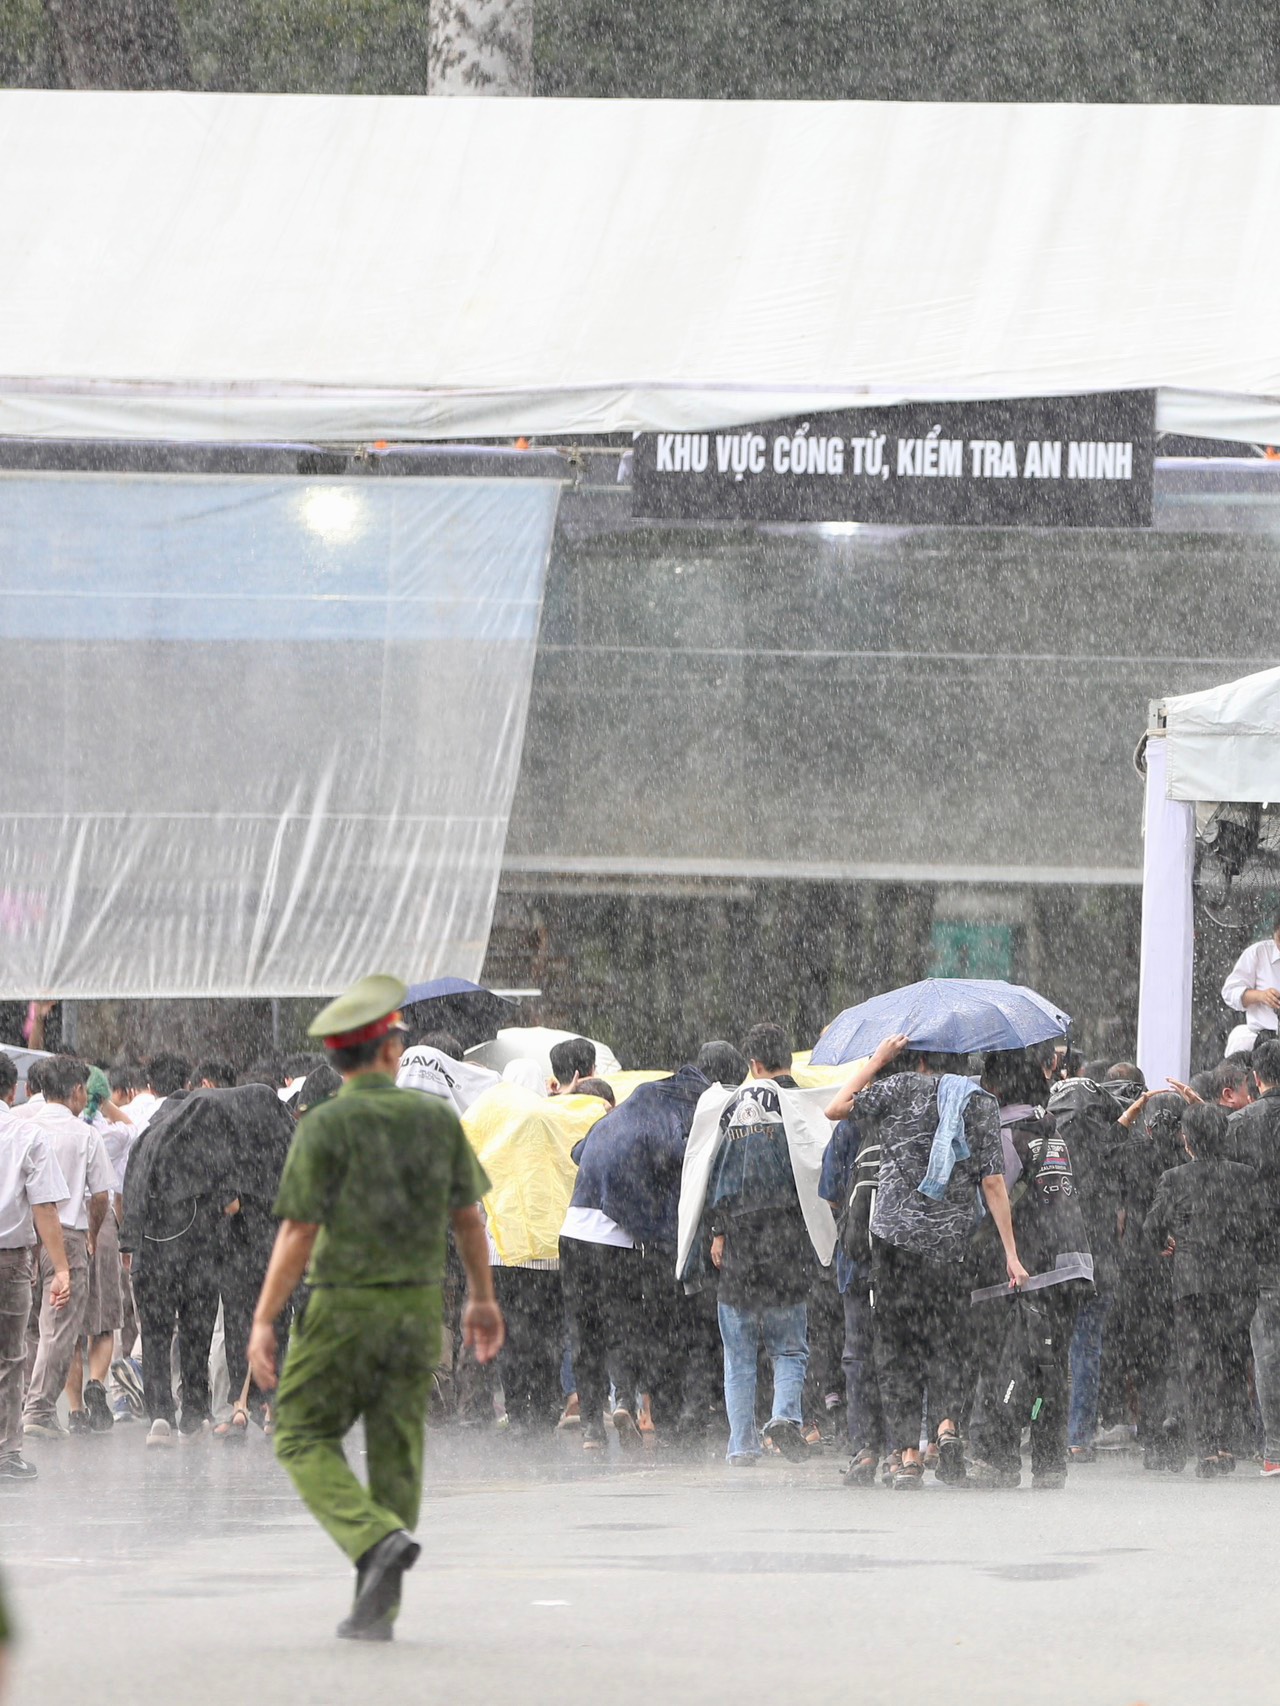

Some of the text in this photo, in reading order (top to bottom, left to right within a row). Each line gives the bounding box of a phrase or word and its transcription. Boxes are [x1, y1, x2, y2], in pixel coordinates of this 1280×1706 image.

[656, 421, 1133, 482] KHU VỰC CỔNG TỪ, KIỂM TRA AN NINH
